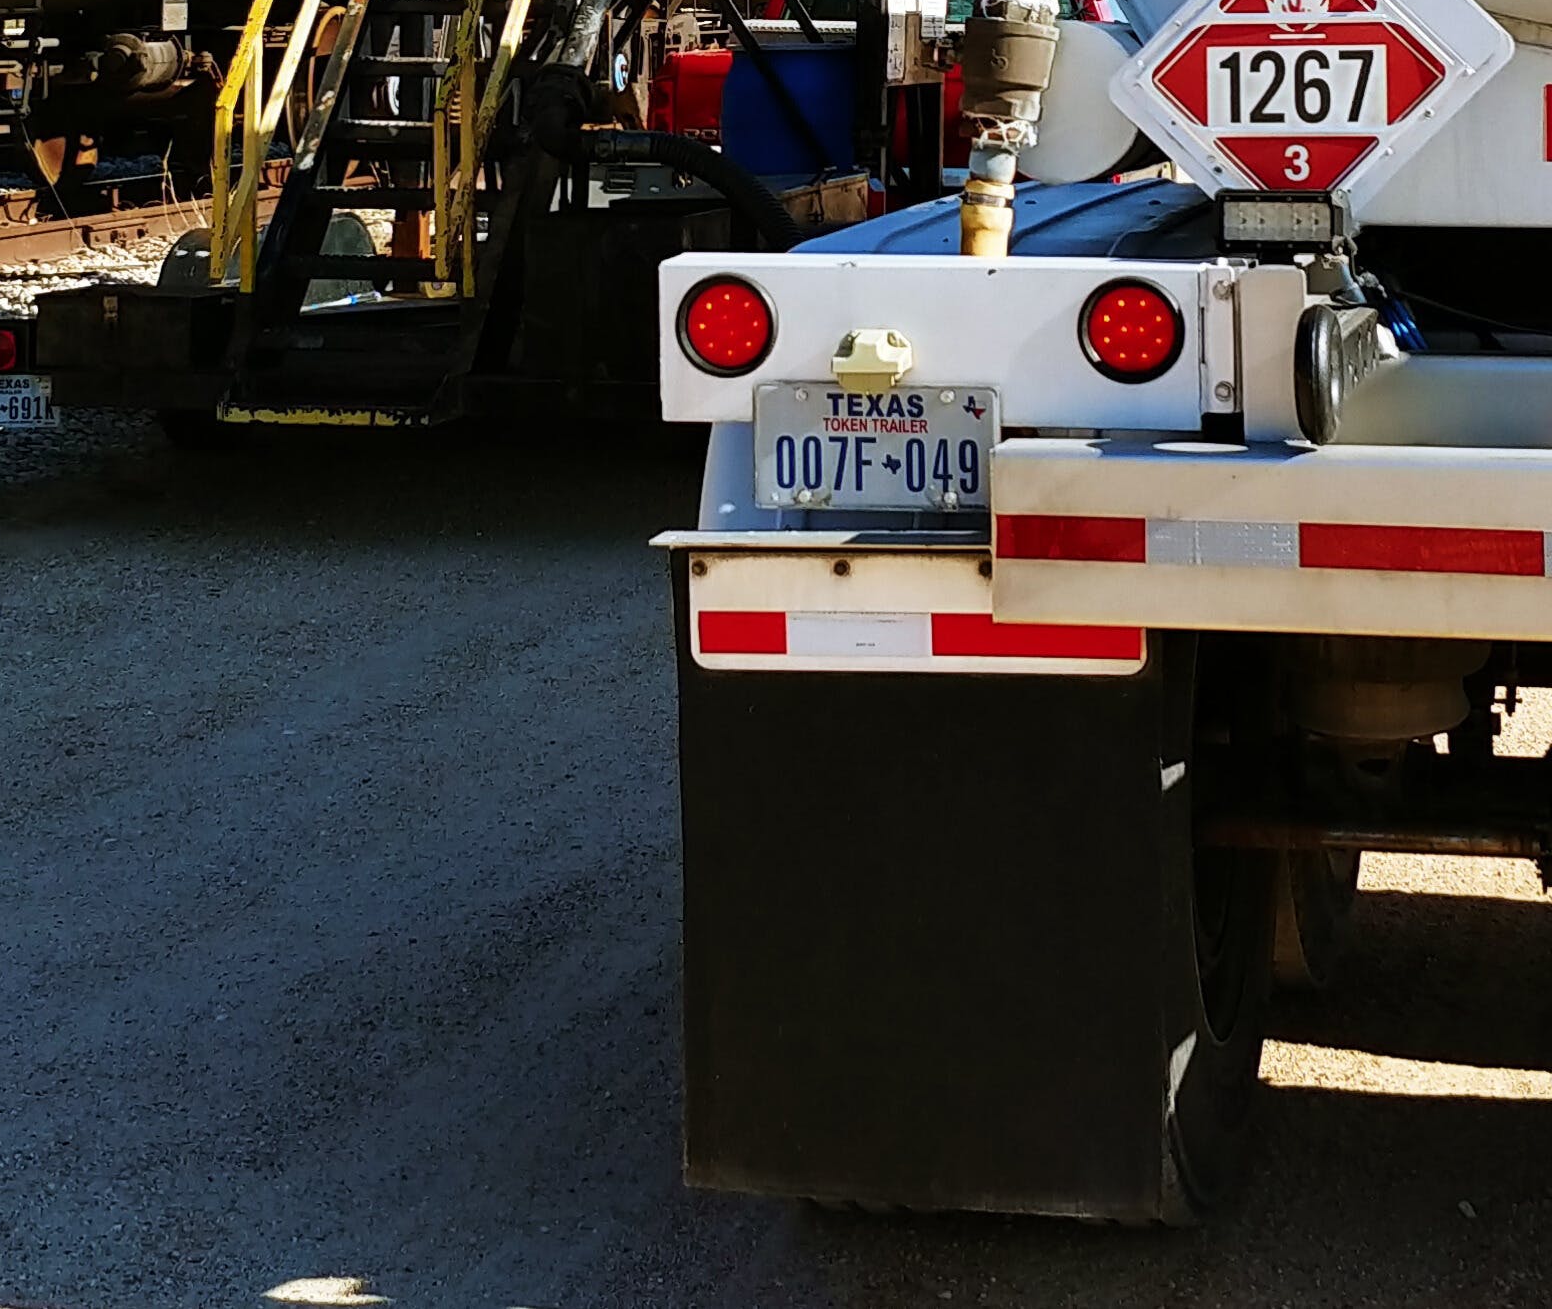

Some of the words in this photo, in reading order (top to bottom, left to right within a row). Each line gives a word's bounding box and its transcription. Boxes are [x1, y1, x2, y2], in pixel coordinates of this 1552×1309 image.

[1218, 49, 1374, 124] 1267
[1283, 144, 1311, 182] 3
[827, 393, 925, 419] TEXAS
[823, 417, 868, 434] TOKEN
[872, 418, 929, 435] TRAILER
